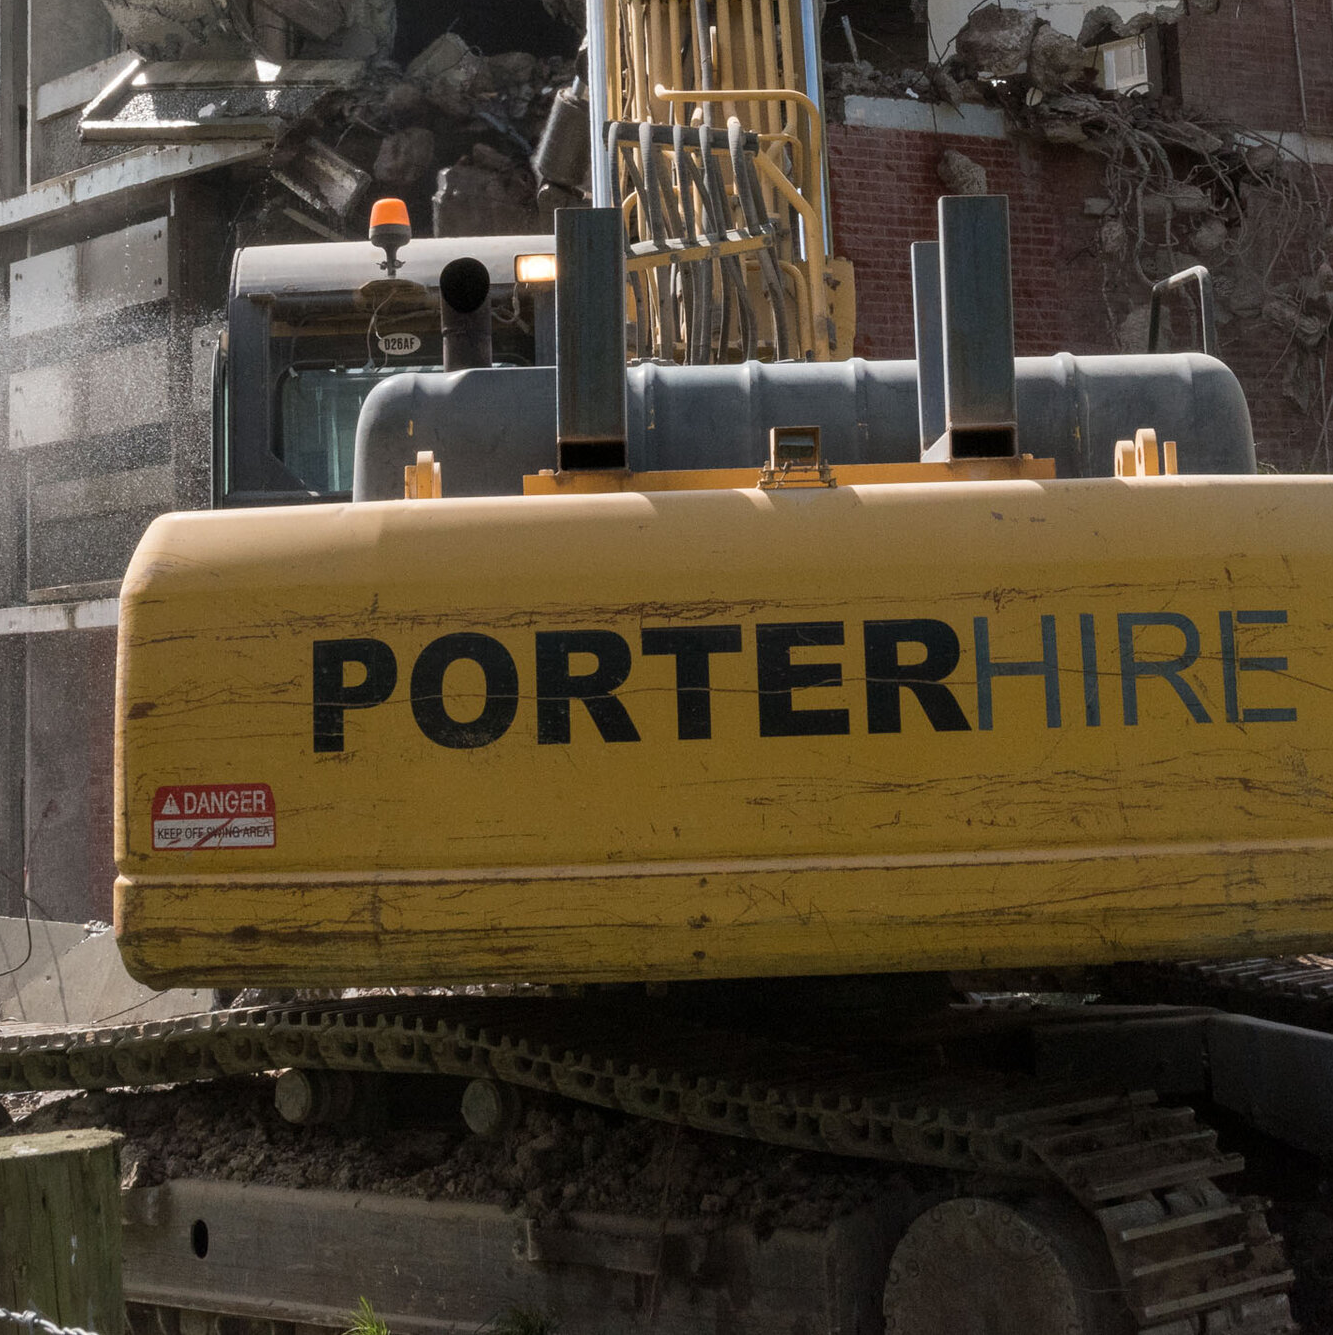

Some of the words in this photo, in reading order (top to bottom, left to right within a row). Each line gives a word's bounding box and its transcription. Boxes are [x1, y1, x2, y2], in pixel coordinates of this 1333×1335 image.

[183, 789, 266, 815] DANGER
[157, 827, 183, 840] KEEP
[185, 826, 204, 839] OFF
[242, 825, 270, 838] AREA
